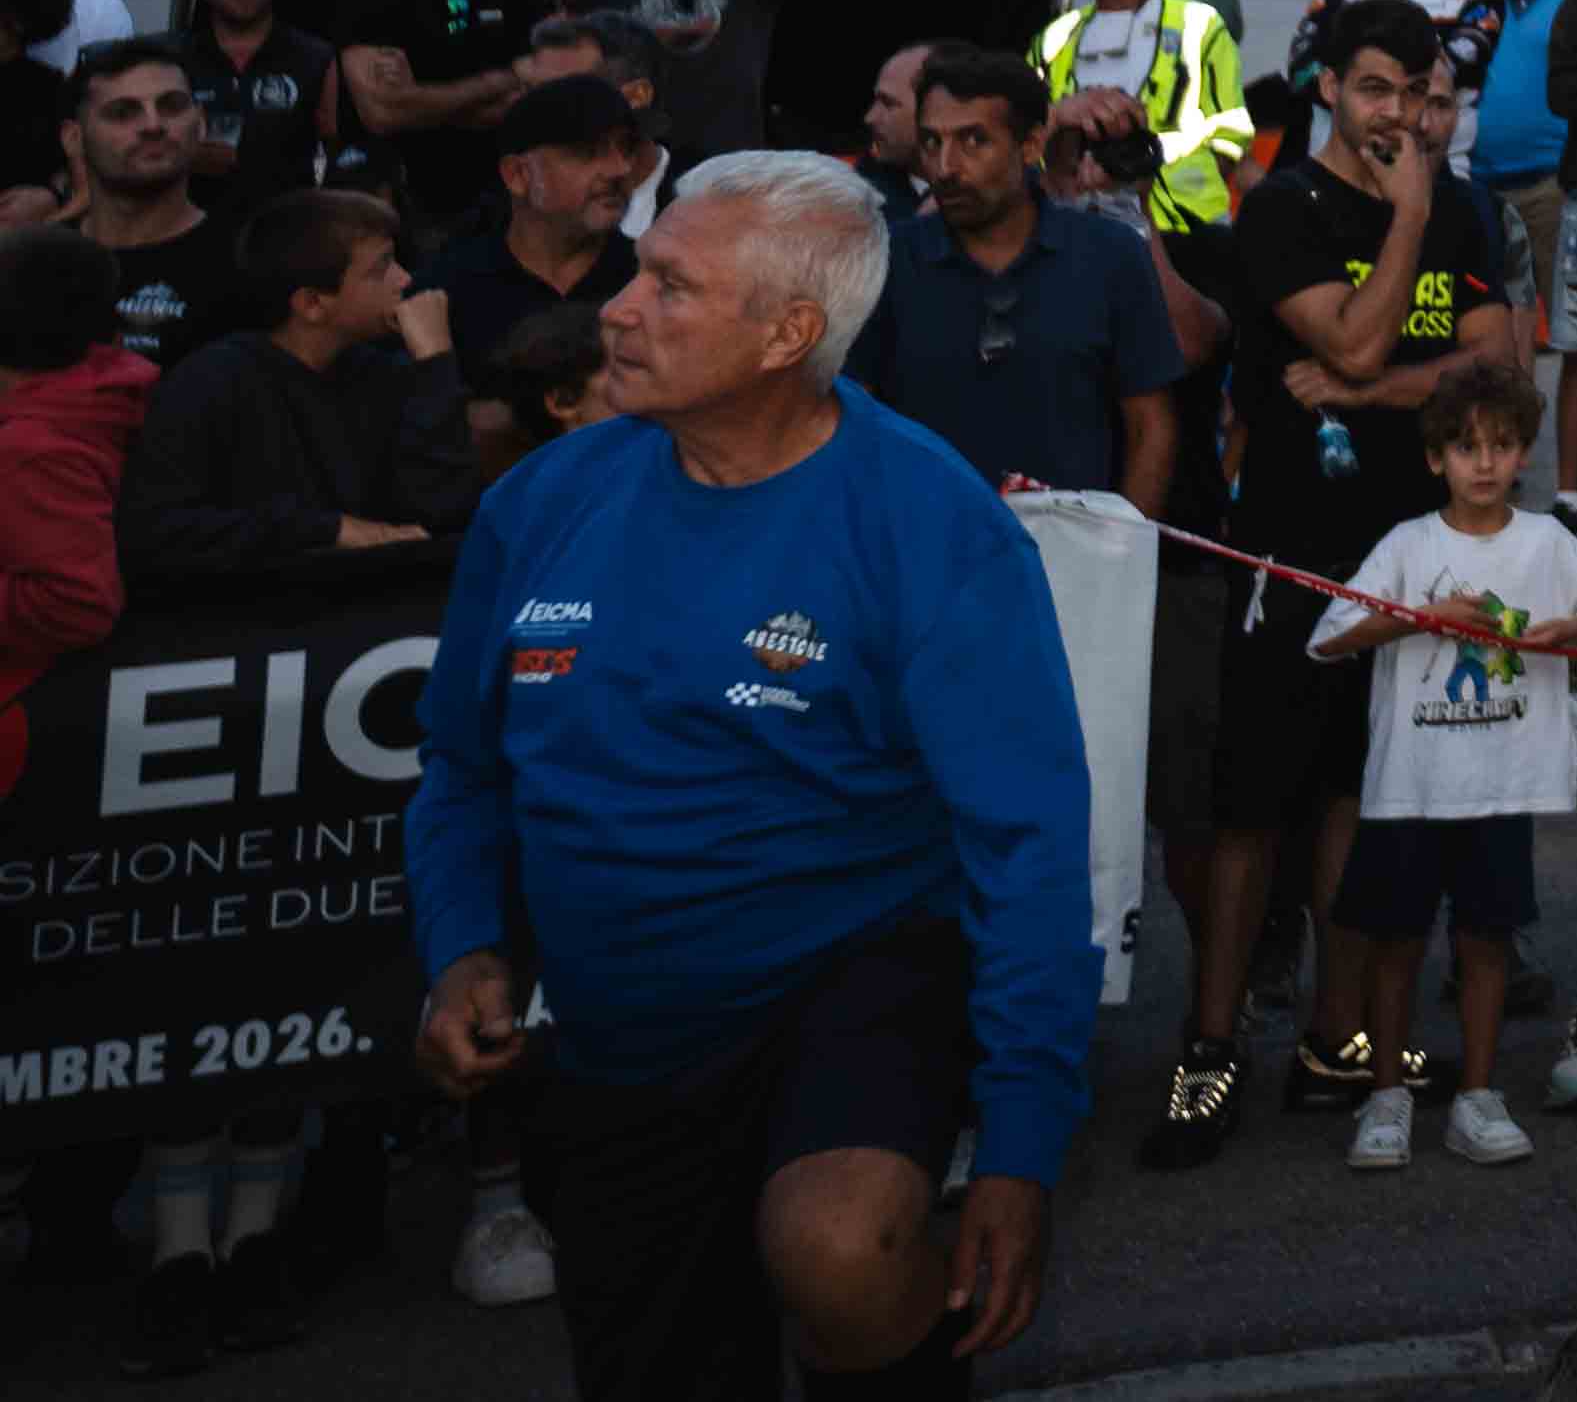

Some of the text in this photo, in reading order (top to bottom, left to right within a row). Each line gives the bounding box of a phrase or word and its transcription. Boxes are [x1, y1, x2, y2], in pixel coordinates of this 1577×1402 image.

[99, 634, 441, 819] EIC
[0, 830, 274, 901] SIZIONE
[32, 873, 403, 964] DELLE DUE
[0, 1007, 374, 1107] MBRE 2026.
